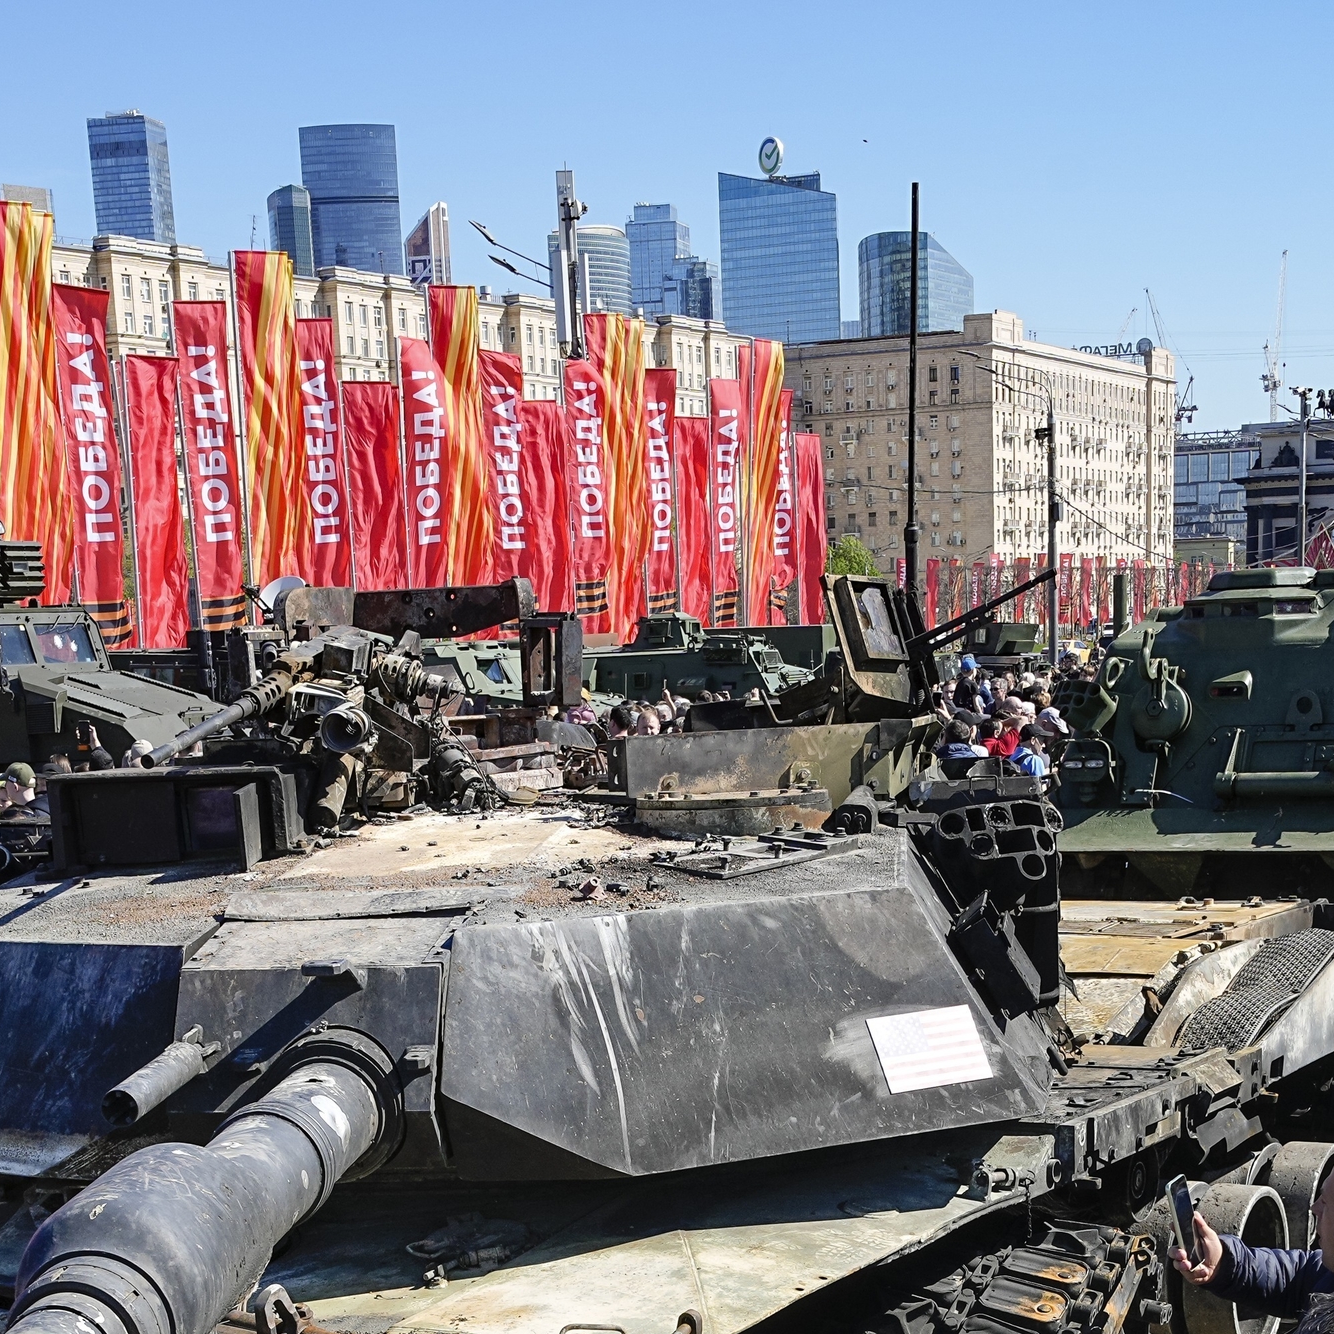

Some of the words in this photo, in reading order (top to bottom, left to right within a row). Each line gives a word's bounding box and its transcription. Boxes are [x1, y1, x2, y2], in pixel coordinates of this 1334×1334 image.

[66, 331, 115, 543] ПОБЕДА!
[187, 344, 233, 543] ПОБЕДА!
[300, 358, 340, 544] ПОБЕДА!
[411, 369, 445, 546] ПОБЕДА!
[490, 385, 526, 550] ПОБЕДА!
[573, 380, 604, 538] ПОБЕДА!
[647, 401, 672, 552] ПОБЕДА!
[717, 408, 739, 553] ПОБЕДА!
